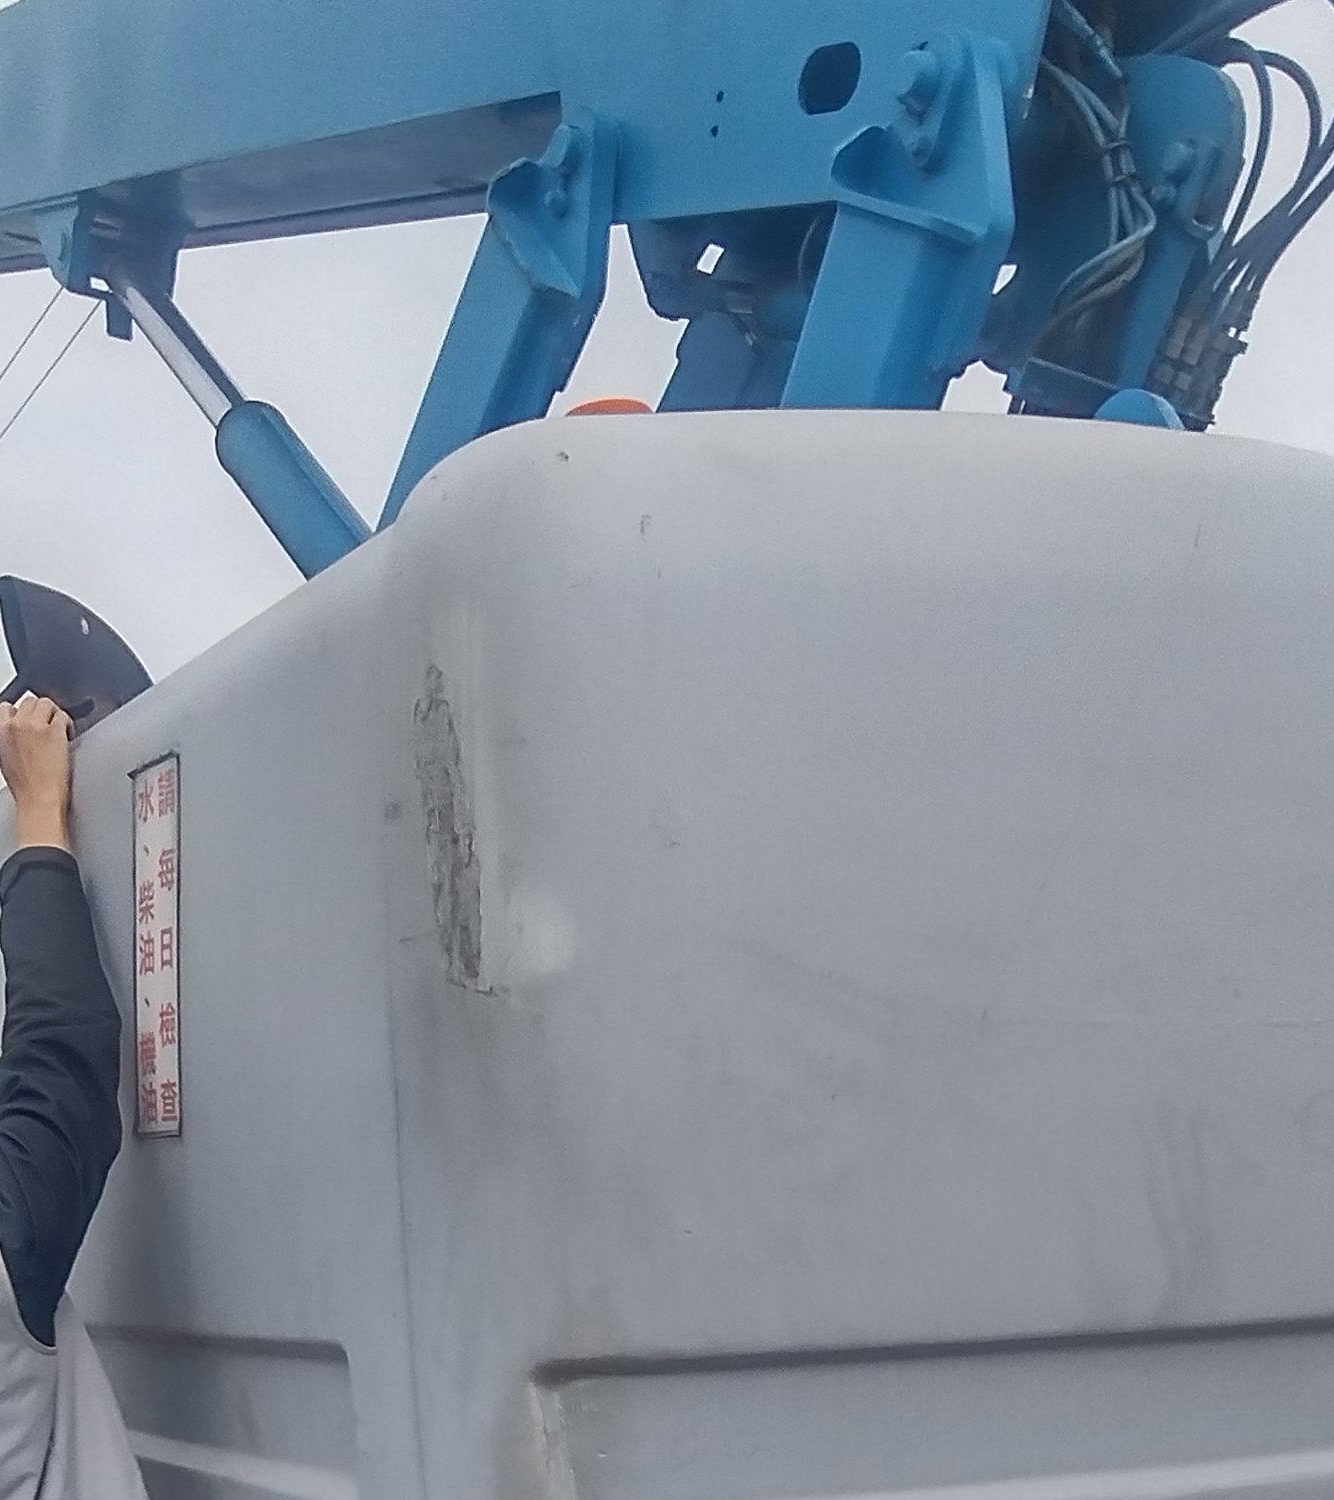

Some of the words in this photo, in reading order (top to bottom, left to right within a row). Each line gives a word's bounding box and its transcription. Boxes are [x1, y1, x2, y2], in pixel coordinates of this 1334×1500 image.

[158, 769, 177, 1122] 請每日檢查
